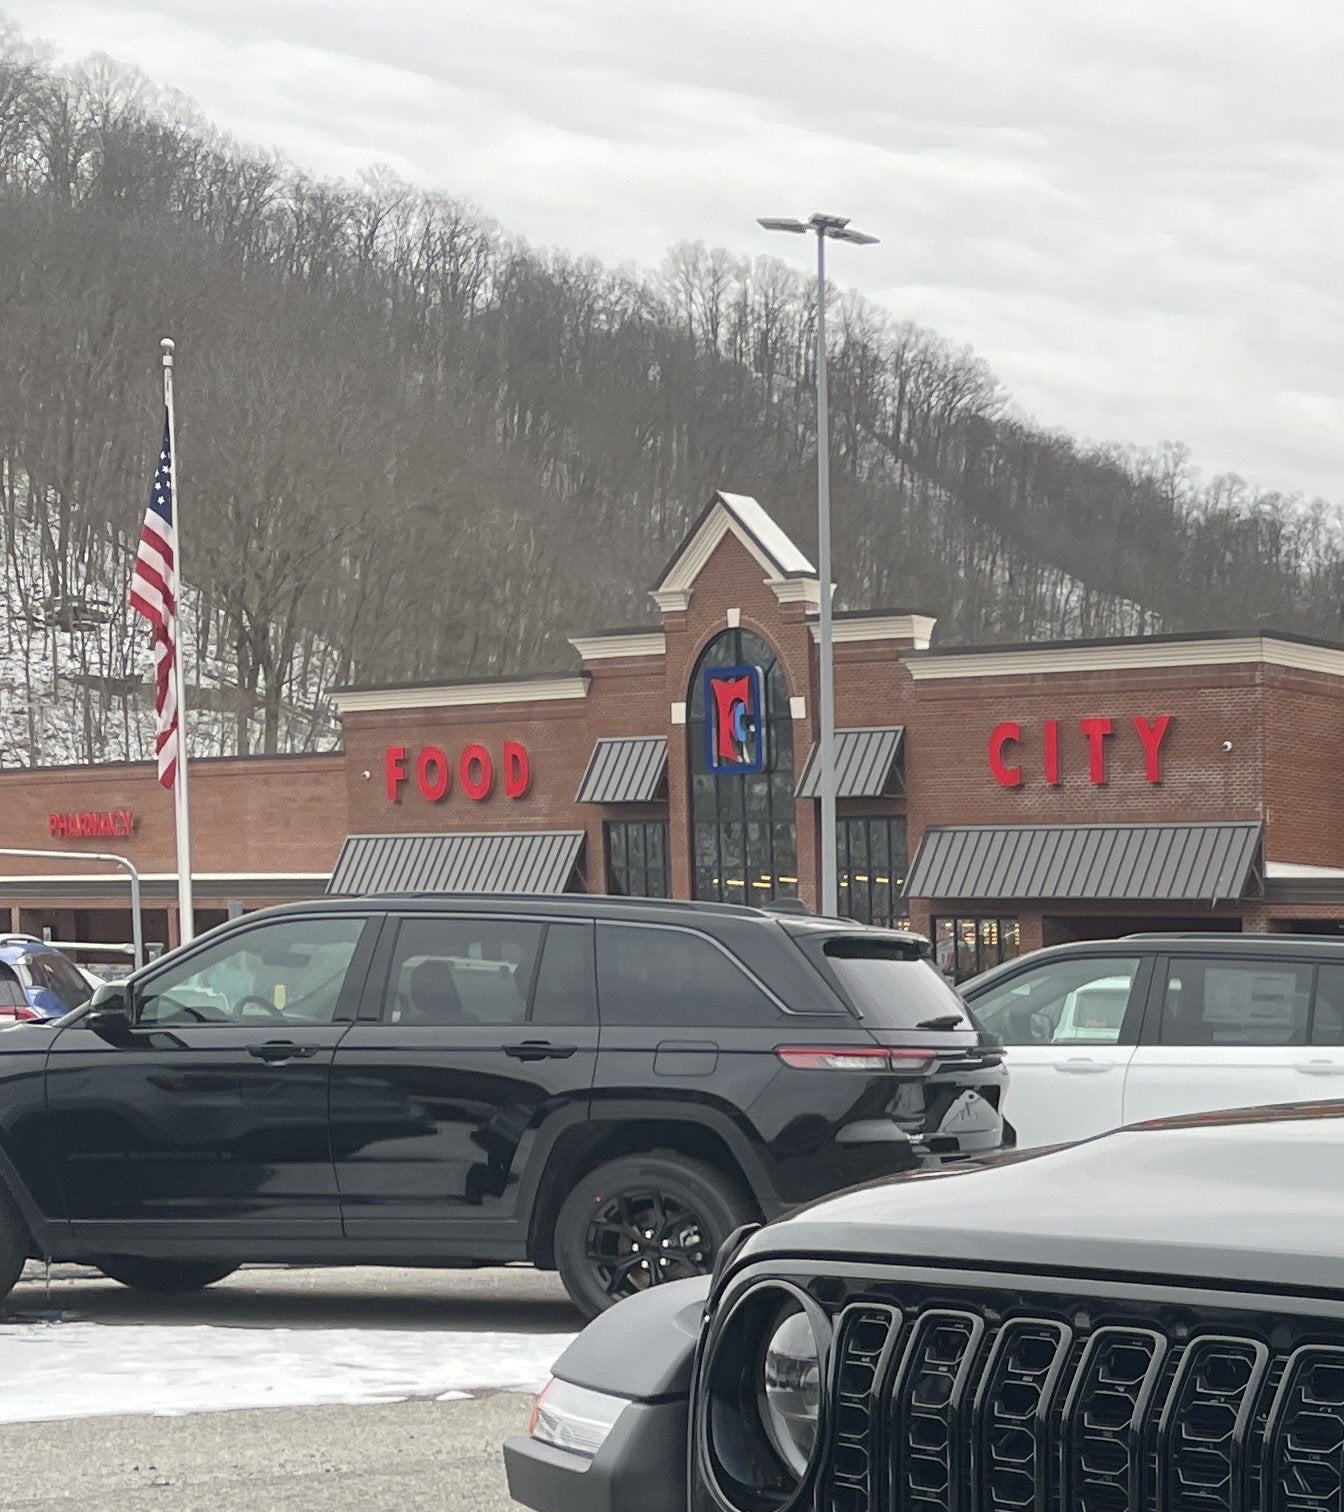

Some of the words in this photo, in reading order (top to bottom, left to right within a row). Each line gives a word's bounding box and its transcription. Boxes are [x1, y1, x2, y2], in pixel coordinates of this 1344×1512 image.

[385, 741, 529, 802] FOOD
[987, 714, 1171, 788] CITY
[48, 811, 132, 838] PHARMACY
